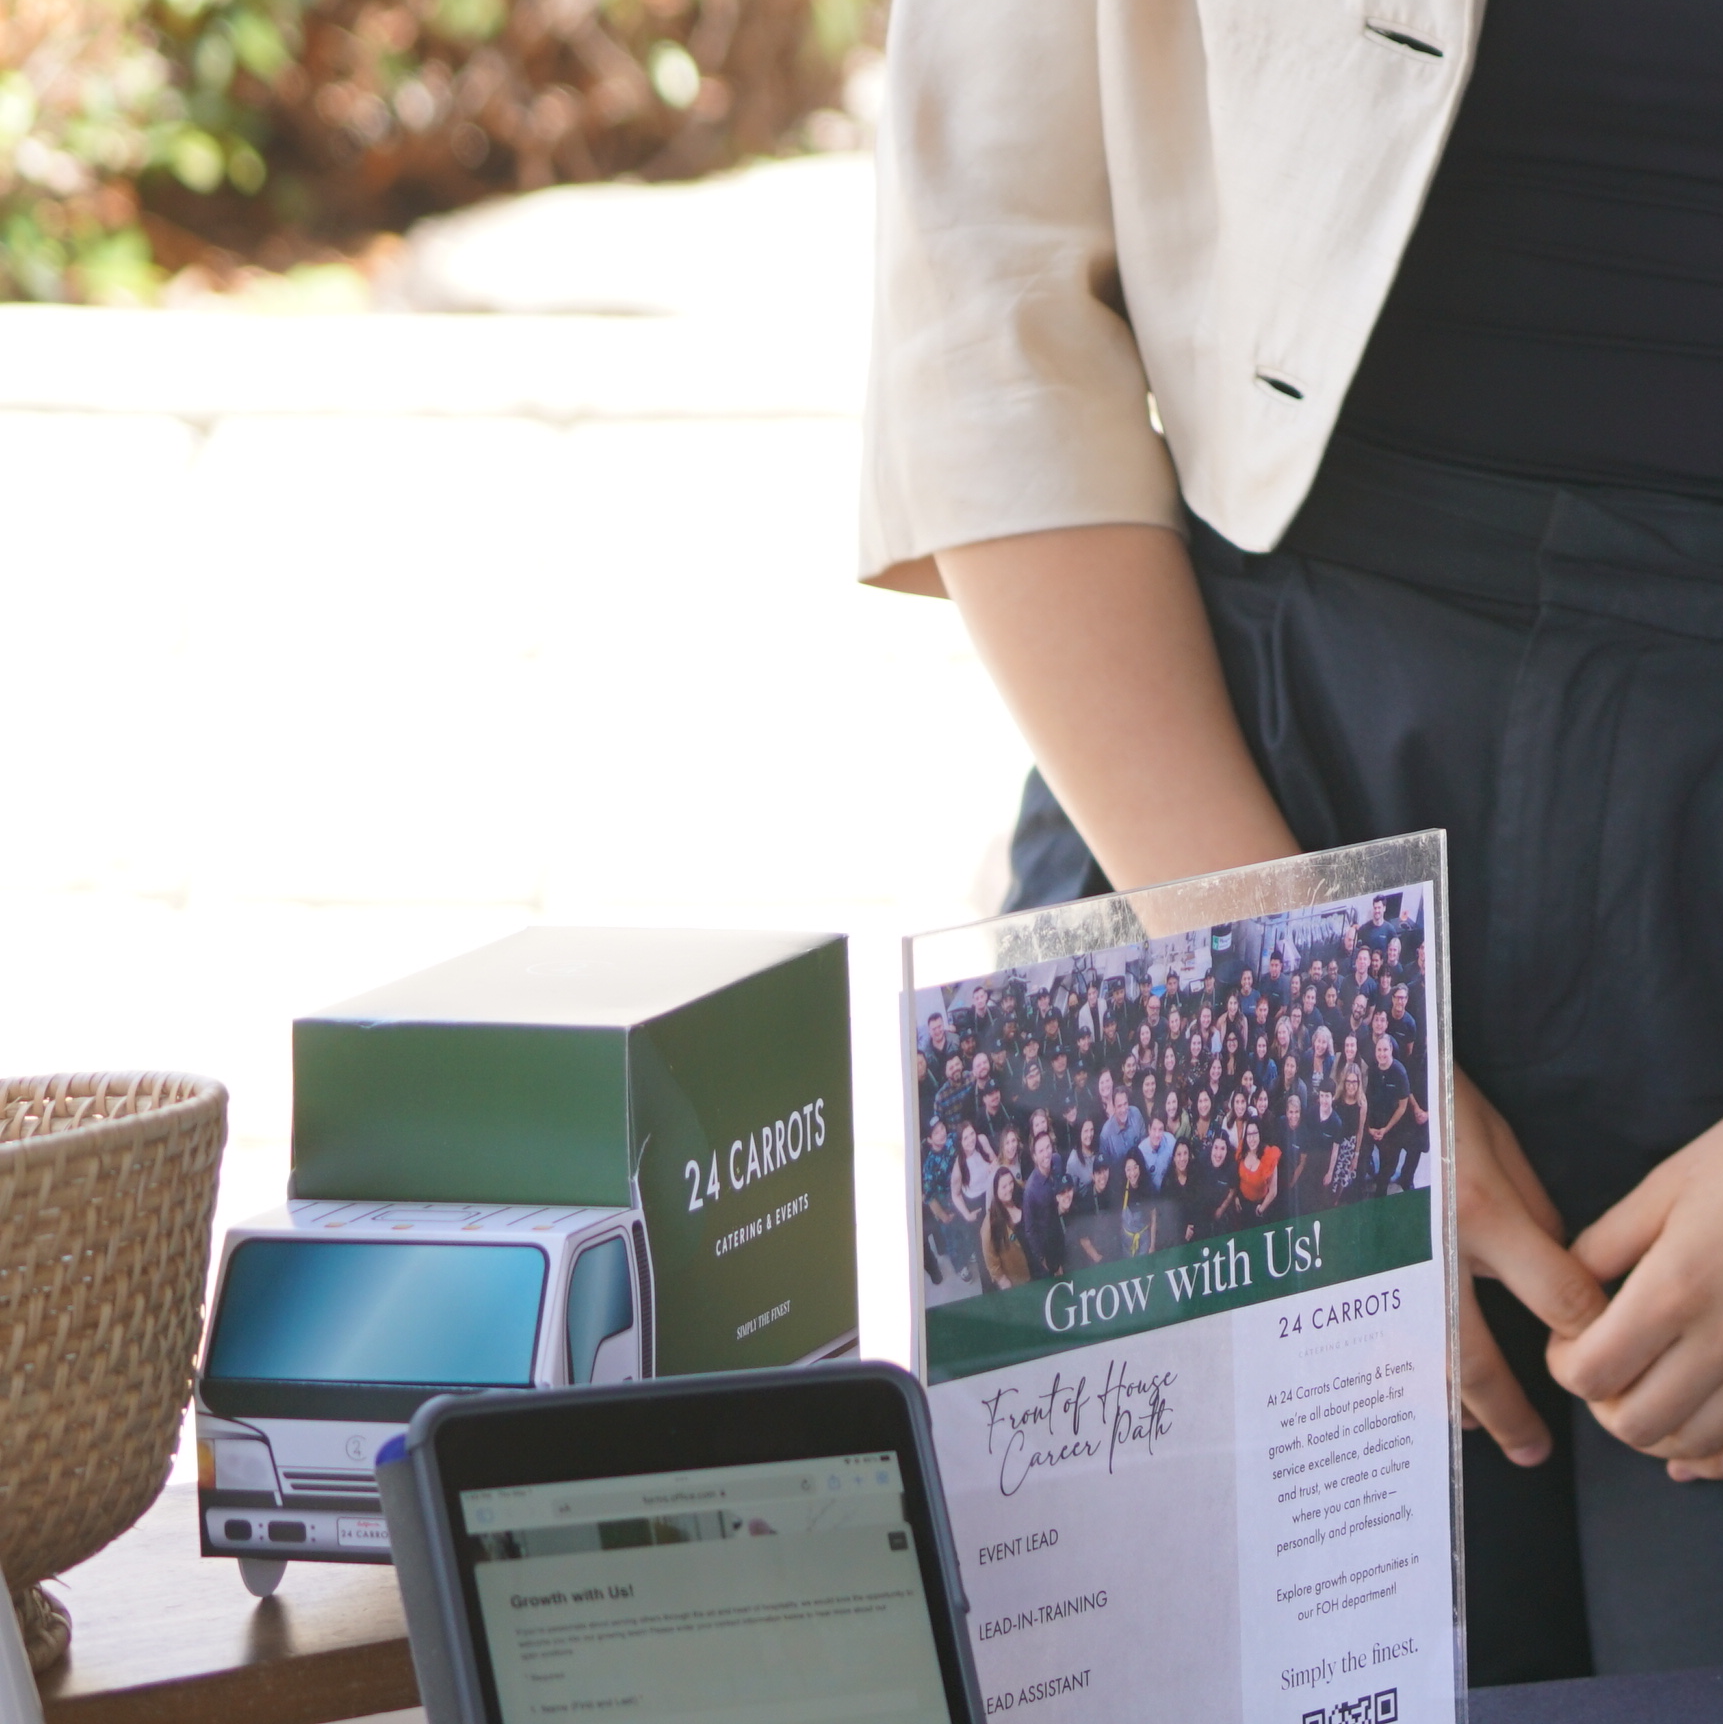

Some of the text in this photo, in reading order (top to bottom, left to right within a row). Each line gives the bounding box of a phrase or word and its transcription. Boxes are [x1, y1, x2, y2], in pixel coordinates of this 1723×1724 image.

[685, 1098, 825, 1212] 24 CARROTS
[716, 1193, 809, 1257] CATERING & EVENTS
[1045, 1220, 1324, 1332] Grow with Us!
[736, 1299, 791, 1340] SIMPLY THE FINEST
[1278, 1288, 1401, 1339] 24 CARROTS
[1298, 1340, 1341, 1358] CATERING
[1352, 1330, 1384, 1346] EVENTS
[981, 1359, 1178, 1454] Front of House
[1266, 1360, 1415, 1408] At 24 Carrots Catering & Events,
[1309, 1405, 1322, 1422] all
[1323, 1400, 1351, 1418] about
[1352, 1386, 1404, 1414] people-first
[1000, 1398, 1173, 1496] Career Path
[1268, 1410, 1416, 1460] growth. Rooted in collaboration,
[1272, 1435, 1414, 1480] service excellence, dedication,
[1277, 1459, 1410, 1504] and trust, we create a culture
[341, 1529, 352, 1538] 24
[1276, 1504, 1414, 1558] personally and professionally.
[1291, 1508, 1322, 1524] where
[1323, 1503, 1342, 1520] you
[1343, 1498, 1361, 1510] can
[979, 1528, 1059, 1565] EVENT LEAD
[510, 1584, 634, 1609] Growth with Us!
[1276, 1552, 1420, 1604] Explore growth opportunities in
[1297, 1581, 1397, 1621] our FOH department!
[979, 1590, 1108, 1641] LEAD-IN-TRAINING
[1281, 1637, 1418, 1691] Simply the finest.
[984, 1669, 1091, 1716] EAD ASSISTANT
